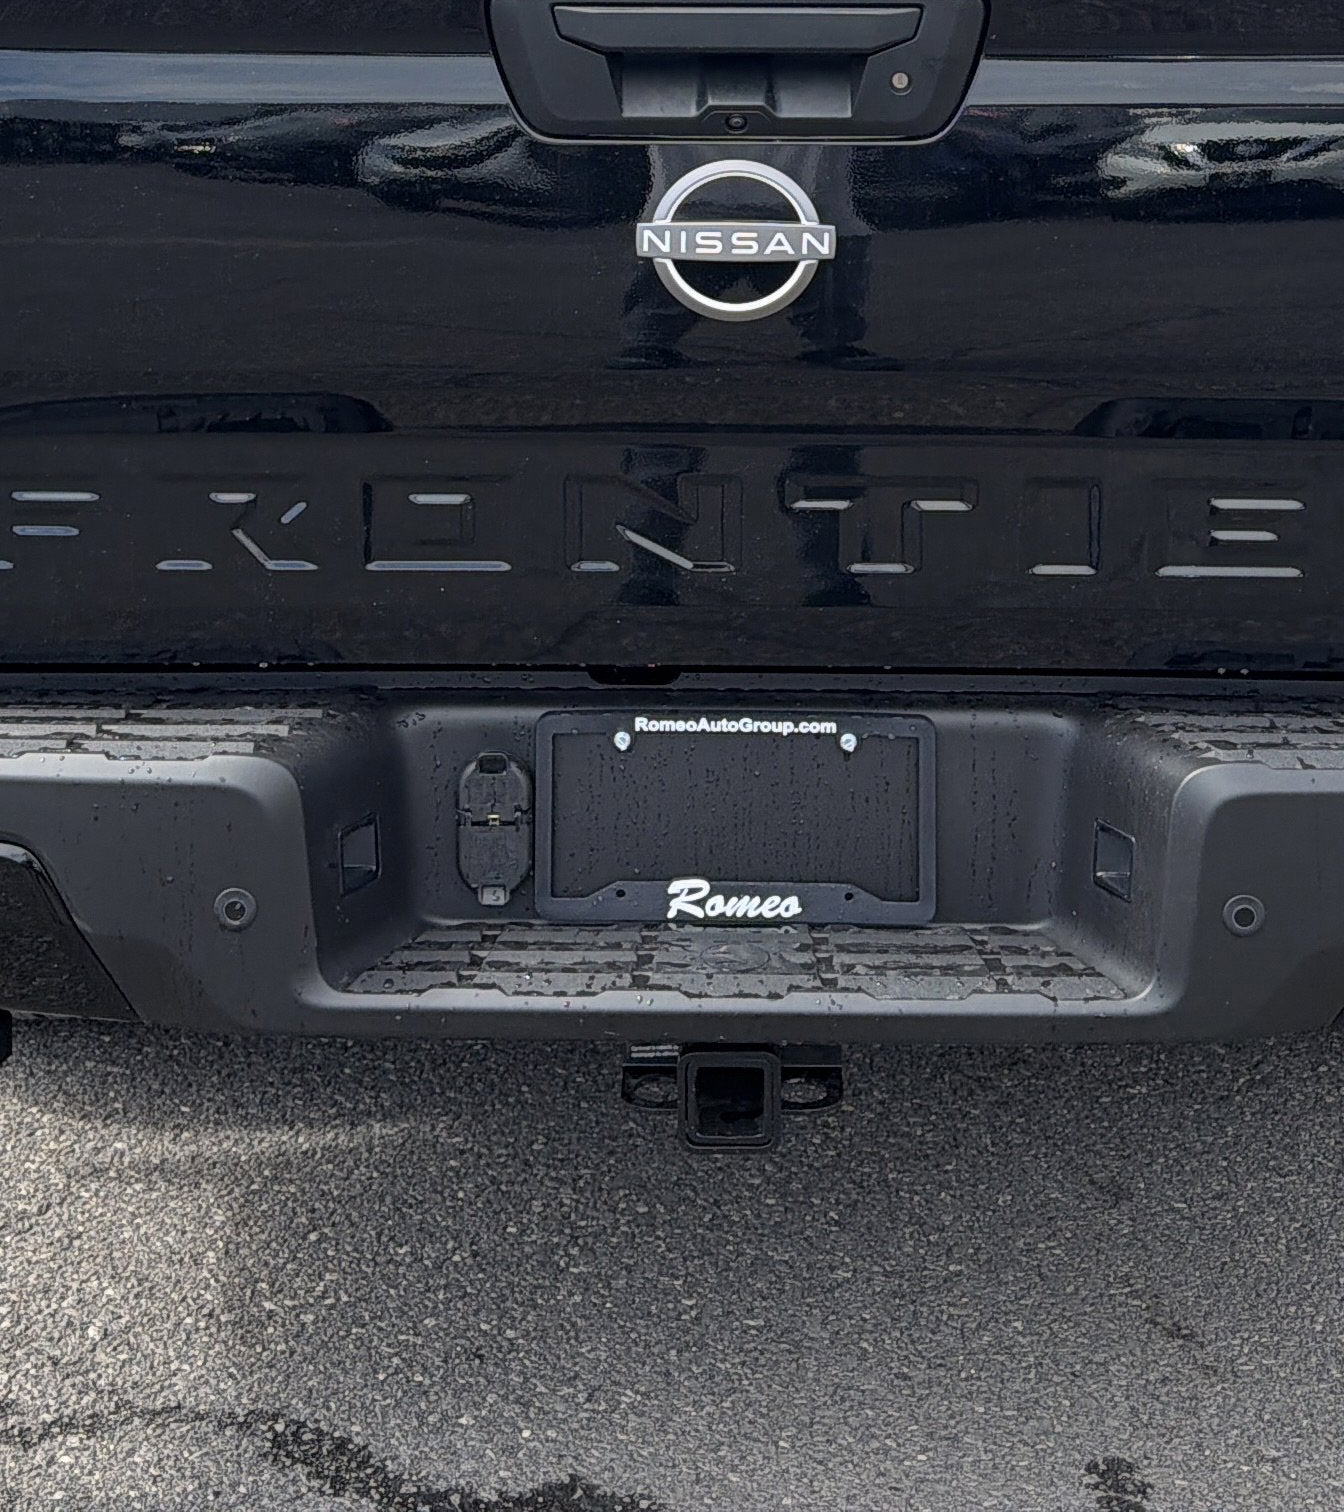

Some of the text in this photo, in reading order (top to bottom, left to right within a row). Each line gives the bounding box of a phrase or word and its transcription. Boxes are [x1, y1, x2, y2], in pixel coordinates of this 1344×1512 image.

[642, 229, 830, 255] NISSAN
[634, 717, 837, 736] RomeoAutoGroup.com
[666, 878, 803, 919] Romeo
